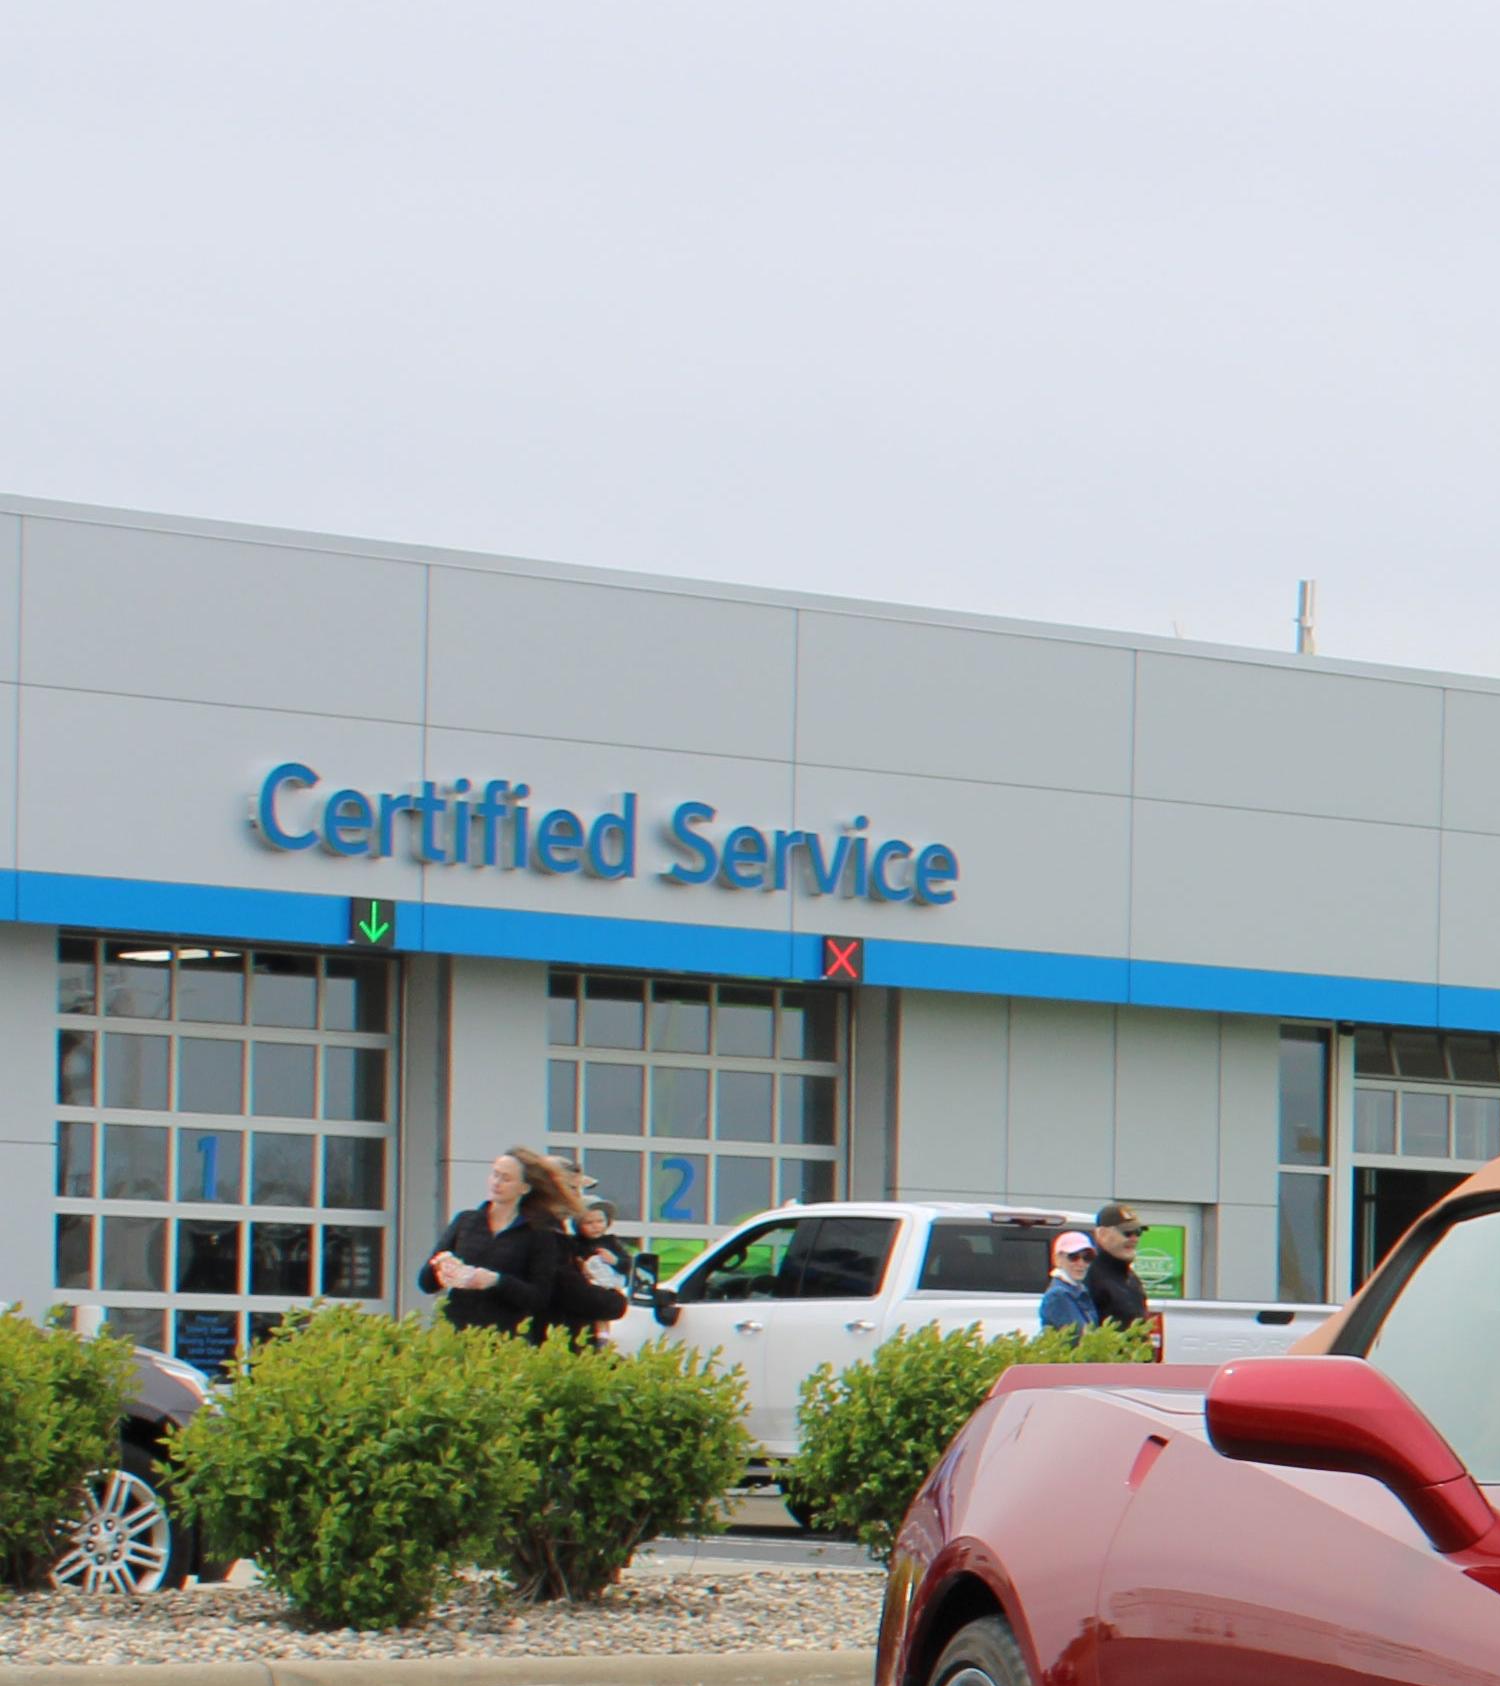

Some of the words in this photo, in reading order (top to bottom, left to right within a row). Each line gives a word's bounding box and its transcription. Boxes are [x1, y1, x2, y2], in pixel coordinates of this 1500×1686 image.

[258, 762, 639, 880] Certified
[667, 800, 960, 904] Service
[196, 1134, 217, 1202] 1
[660, 1156, 697, 1222] 2
